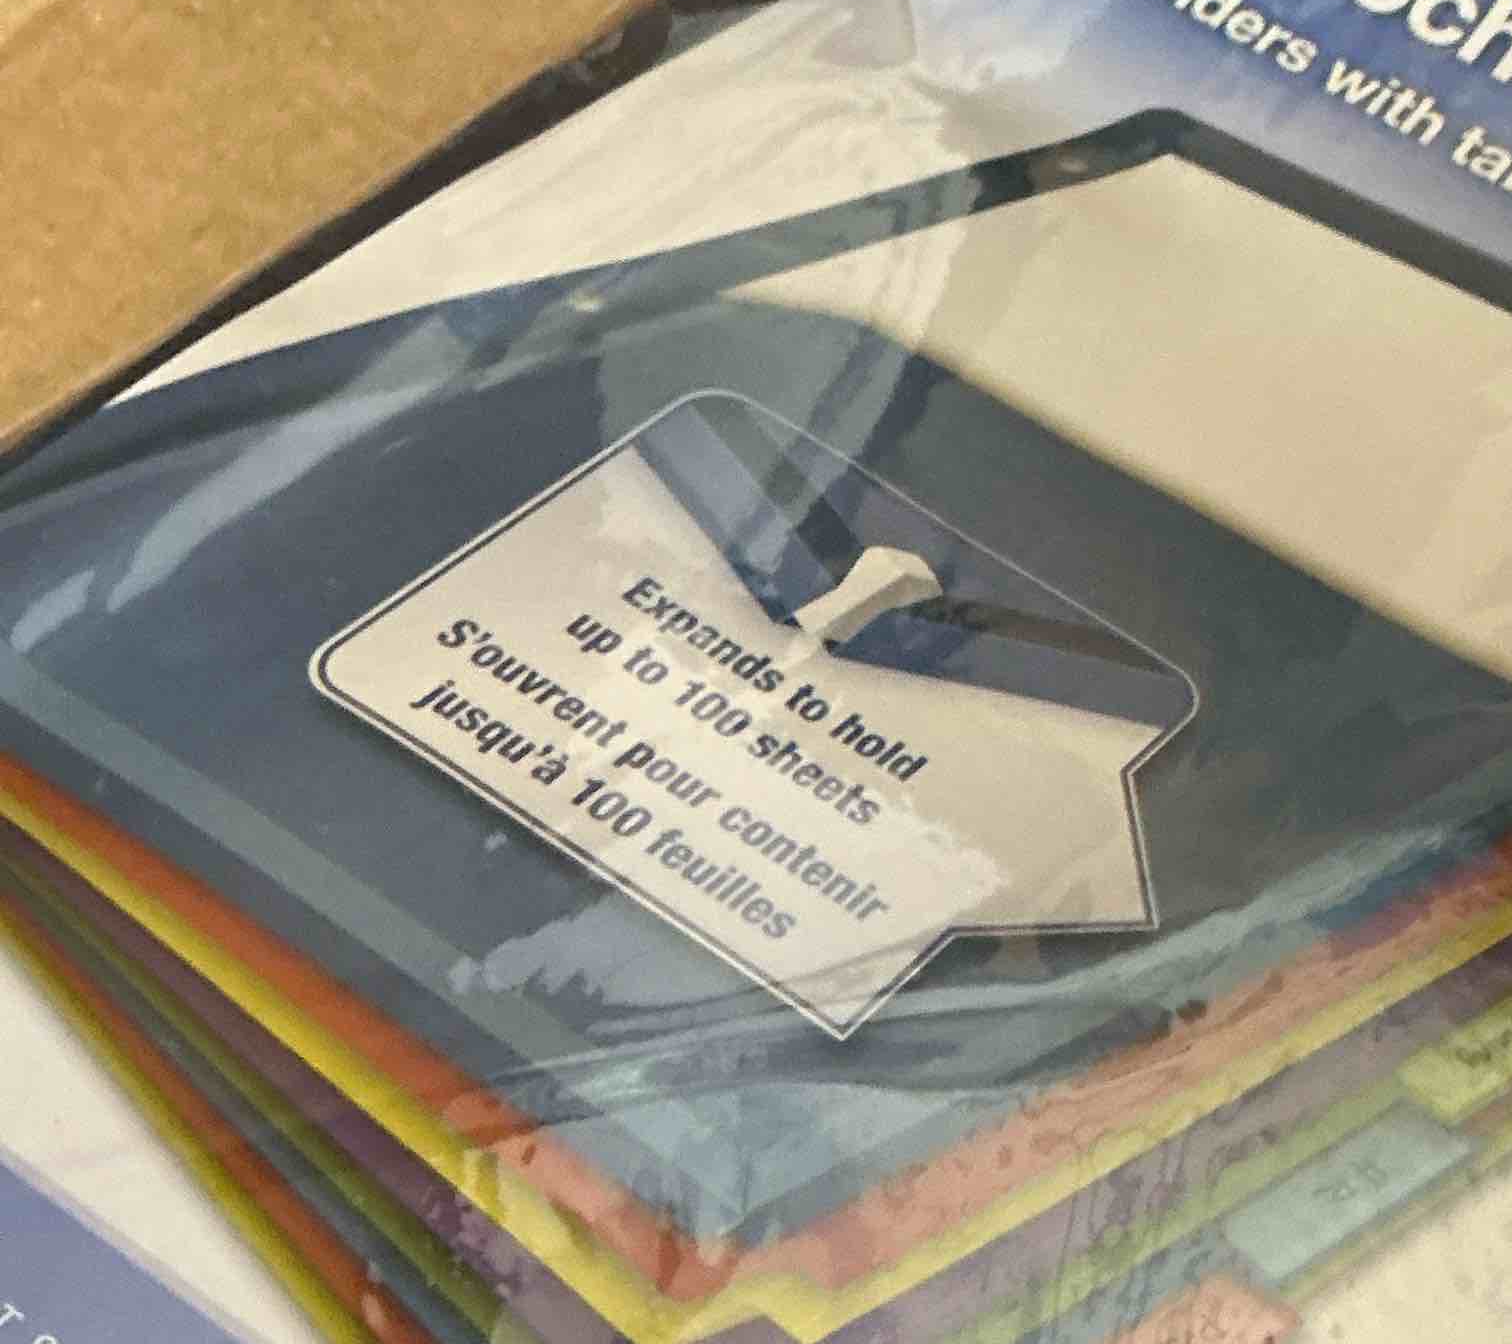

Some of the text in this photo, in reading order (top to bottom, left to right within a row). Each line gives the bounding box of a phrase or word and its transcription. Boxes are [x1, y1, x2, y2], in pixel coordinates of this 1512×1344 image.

[1325, 57, 1445, 147] with
[436, 616, 889, 925] S'ouvrent pour contenir
[564, 612, 881, 826] up to 100 sheets
[621, 575, 928, 785] Expands to hold
[410, 678, 797, 944] jusqu'à 100 feuilles
